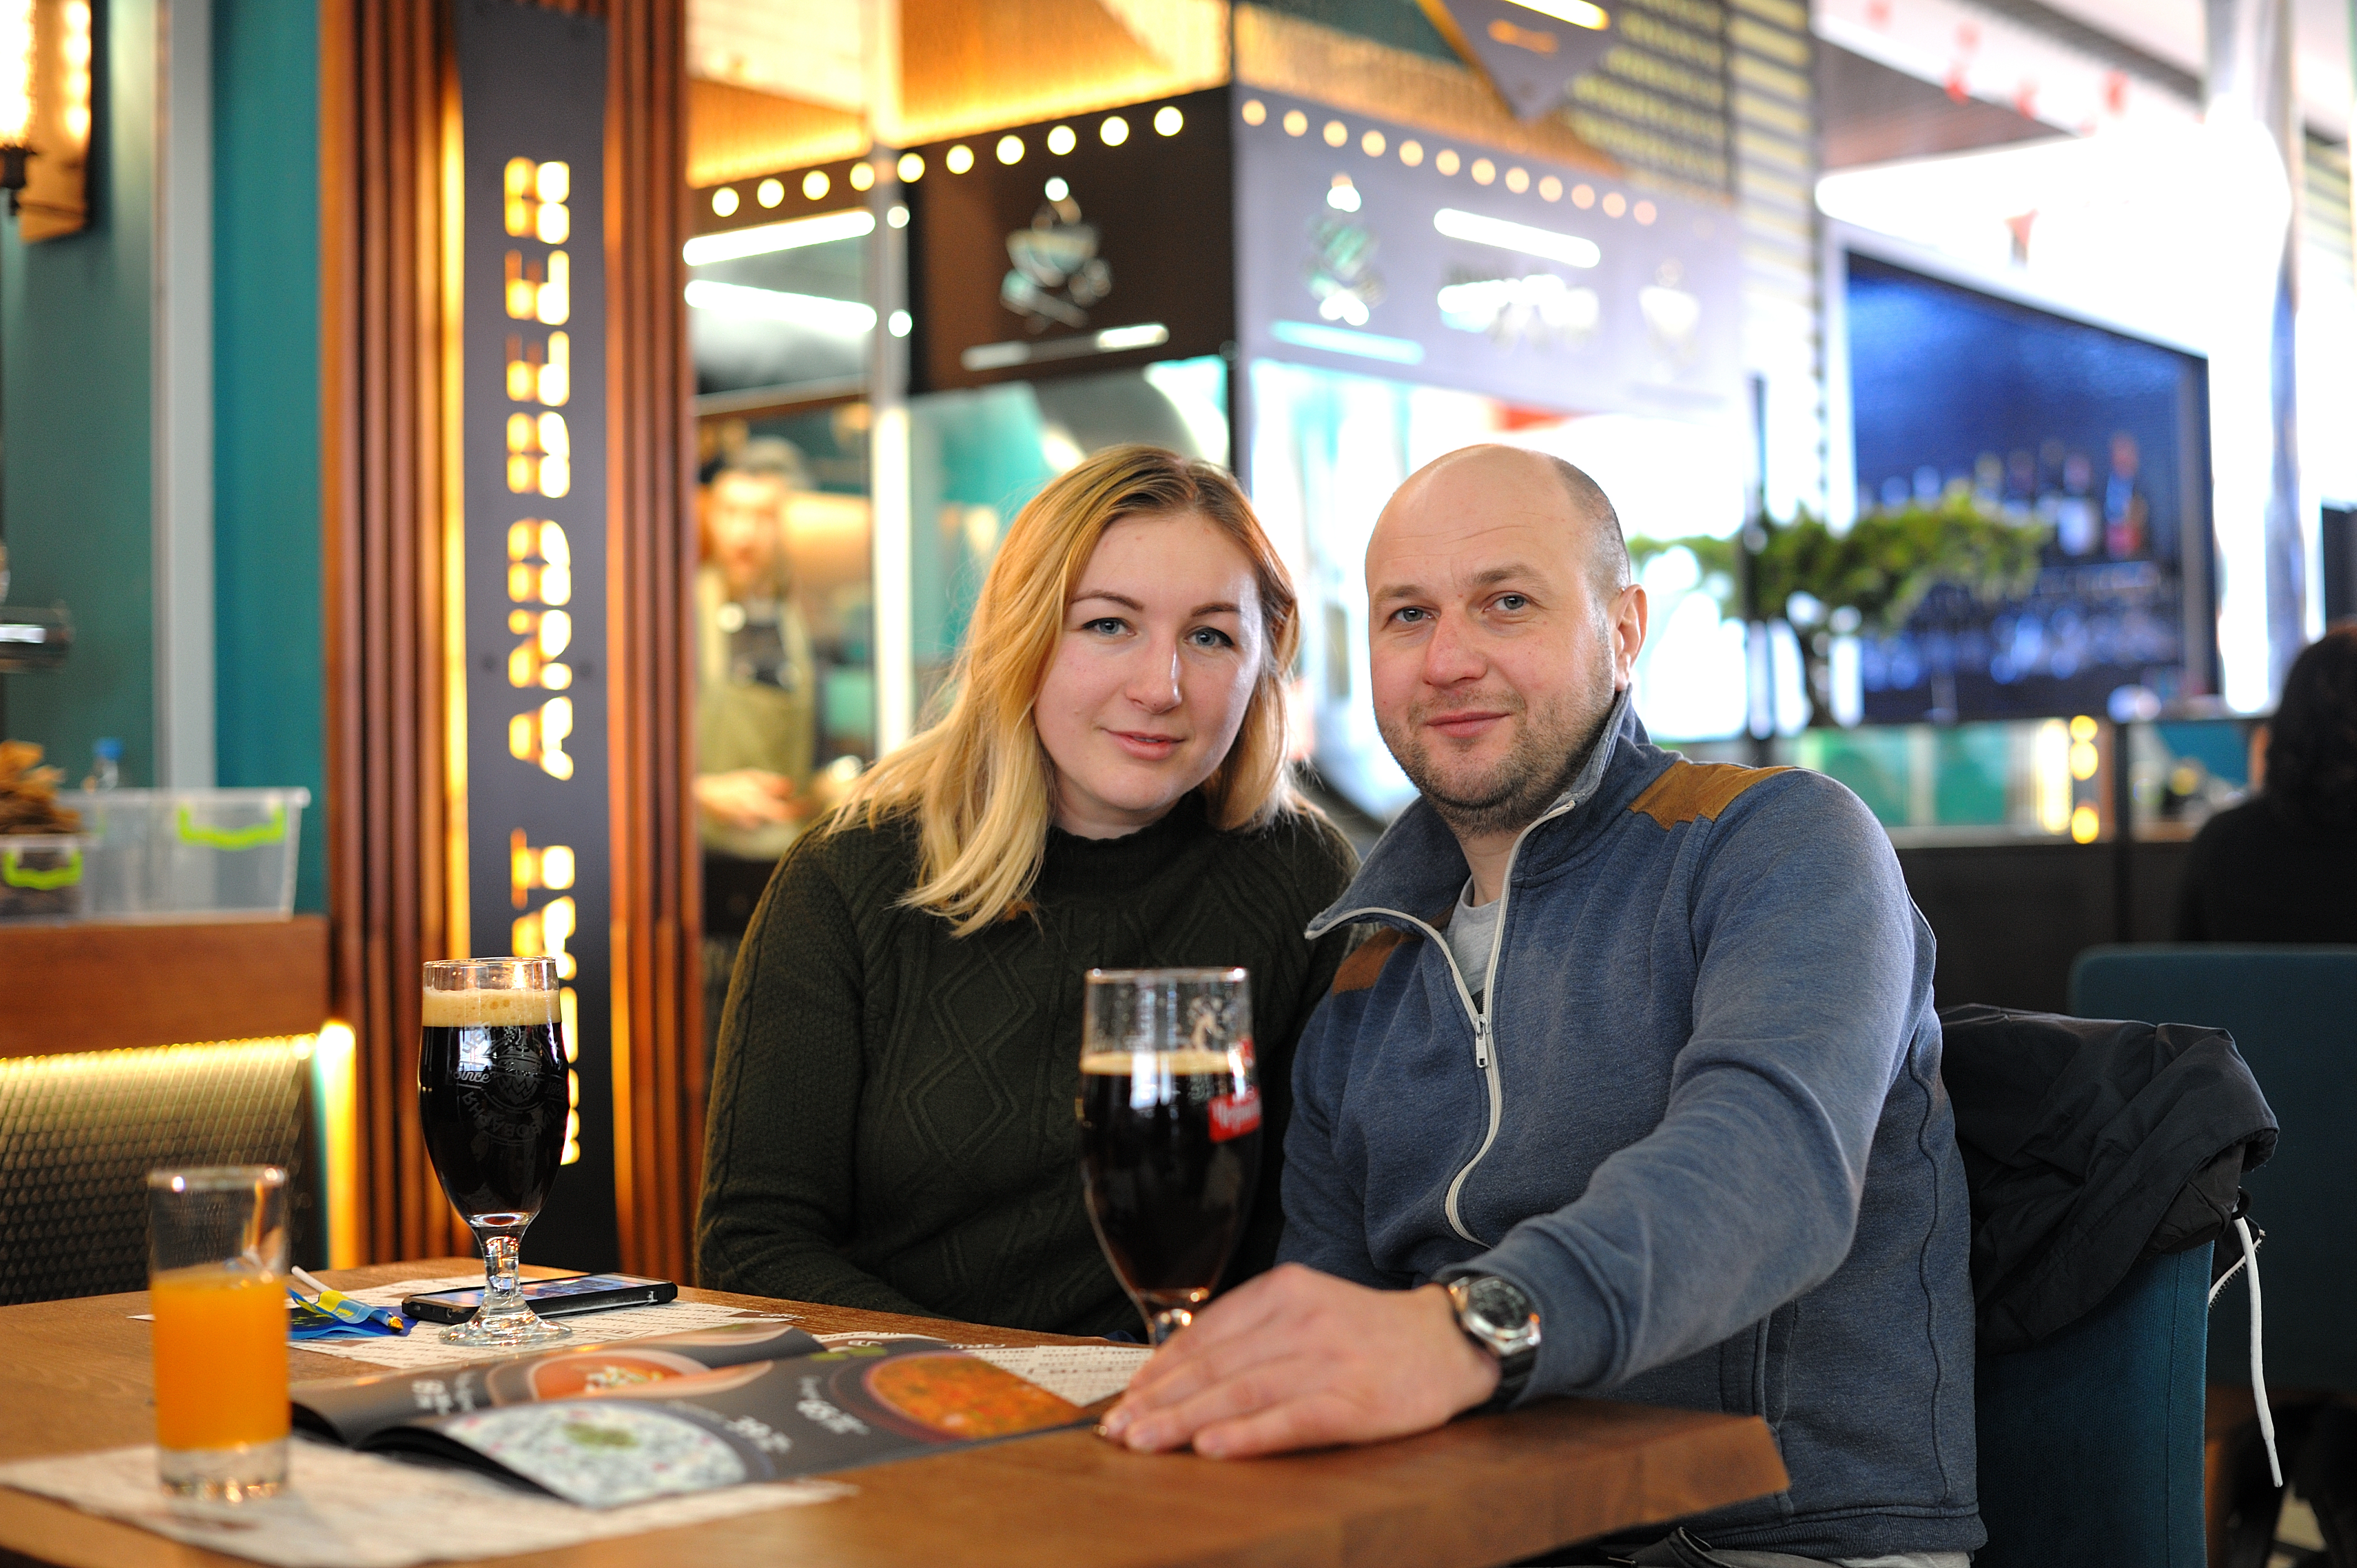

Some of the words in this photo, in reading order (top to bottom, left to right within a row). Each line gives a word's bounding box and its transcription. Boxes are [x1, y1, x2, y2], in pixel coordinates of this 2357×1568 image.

[503, 156, 570, 498] BEER
[507, 517, 573, 780] AND
[452, 1067, 491, 1085] Since
